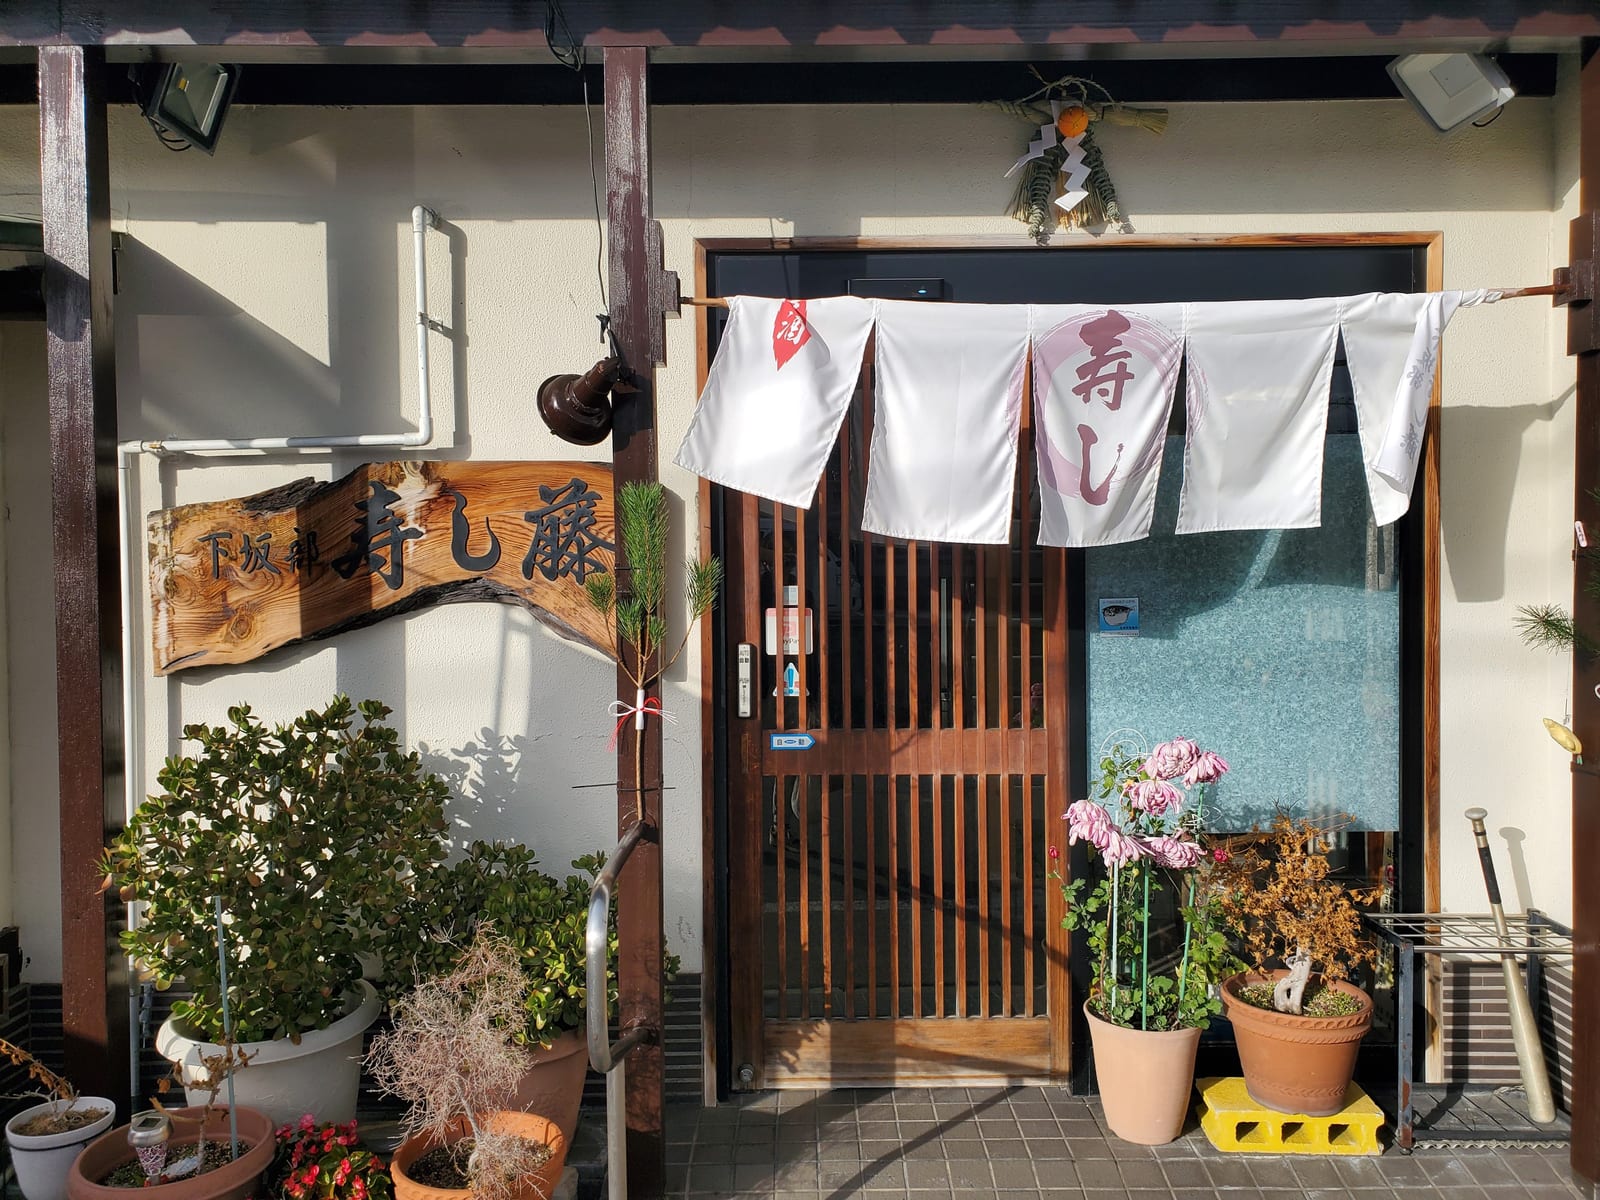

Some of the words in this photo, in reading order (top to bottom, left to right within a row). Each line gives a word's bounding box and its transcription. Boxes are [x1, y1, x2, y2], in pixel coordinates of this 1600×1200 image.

[1071, 309, 1135, 506] 寿し
[198, 526, 320, 580] 下坂部
[331, 477, 615, 591] 寿し藤
